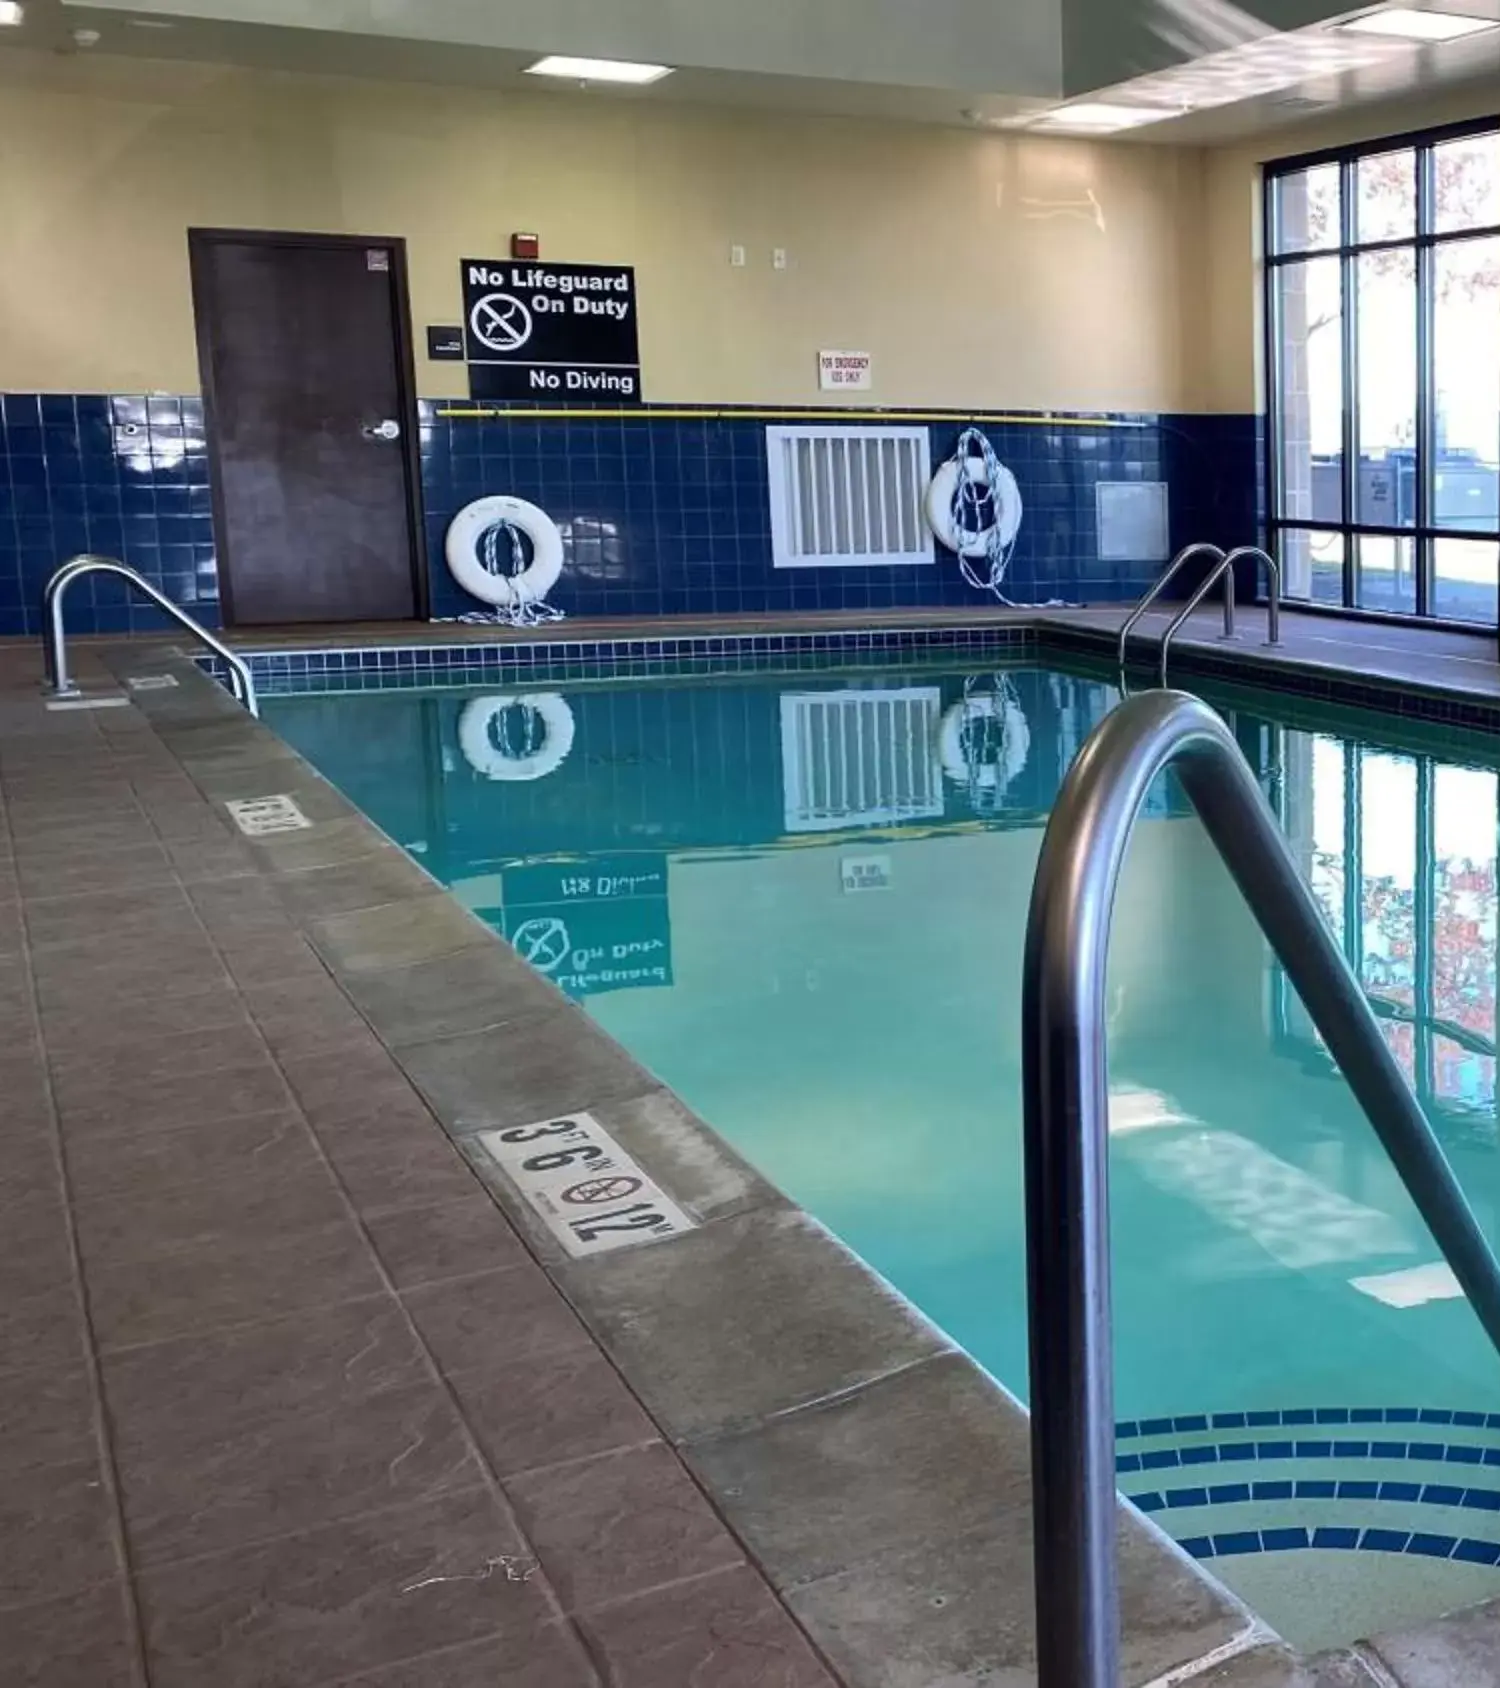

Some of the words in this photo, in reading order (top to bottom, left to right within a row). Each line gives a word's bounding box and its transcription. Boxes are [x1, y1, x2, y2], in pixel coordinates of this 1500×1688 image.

[469, 267, 503, 286] No
[512, 269, 628, 293] Lifeguard
[532, 295, 565, 313] On
[573, 296, 629, 320] Duty
[529, 370, 560, 389] No
[566, 371, 634, 394] Diving
[501, 1120, 578, 1143] 3
[522, 1145, 604, 1171] 6
